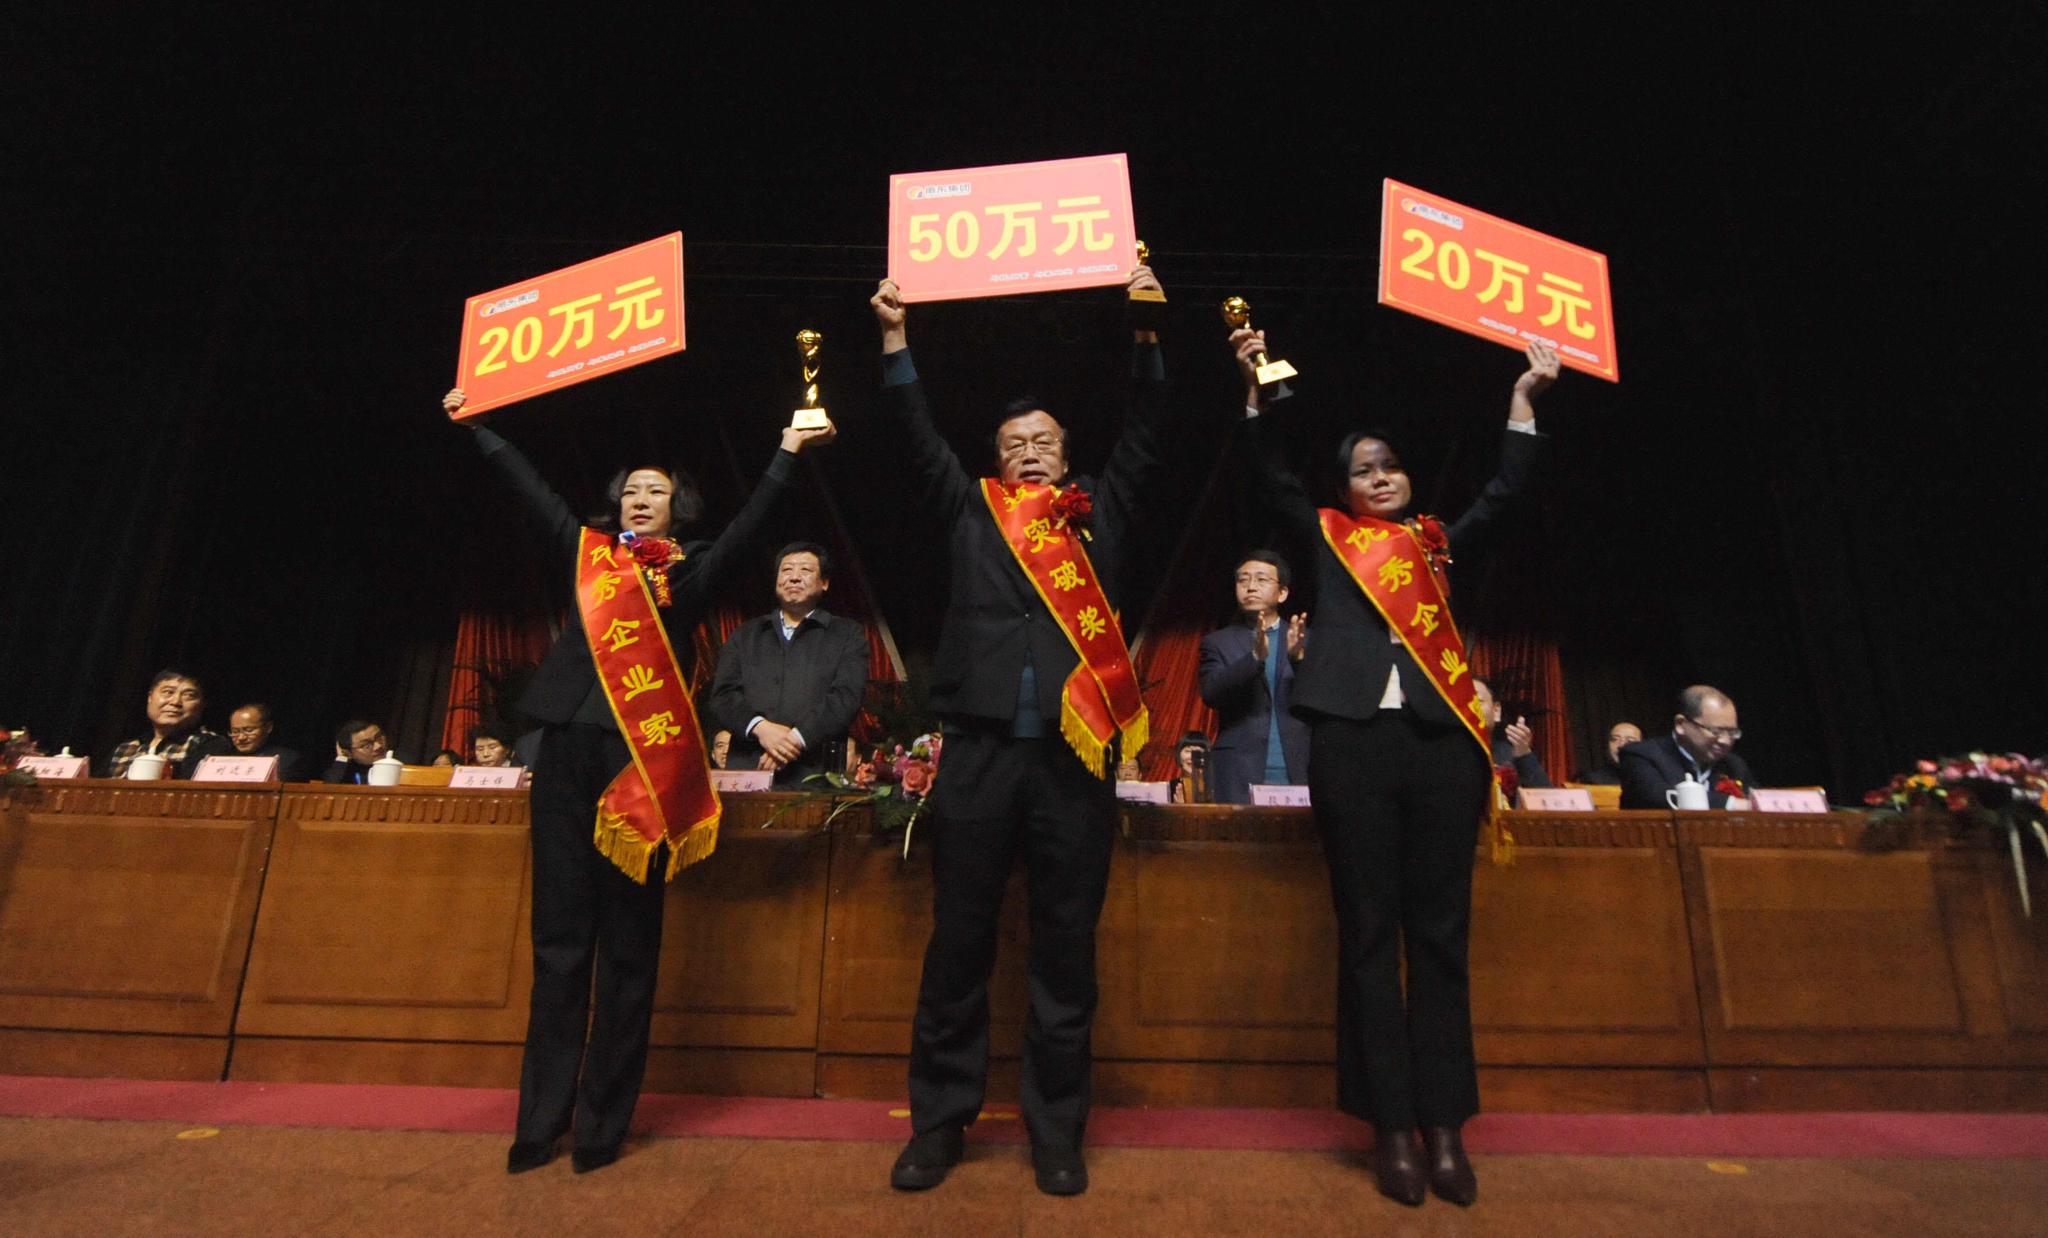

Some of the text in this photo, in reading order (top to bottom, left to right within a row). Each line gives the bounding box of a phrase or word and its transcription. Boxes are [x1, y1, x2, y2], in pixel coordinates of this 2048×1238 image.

[908, 195, 1115, 262] 50万元
[474, 275, 665, 377] 20万元
[1400, 228, 1596, 340] 20万元
